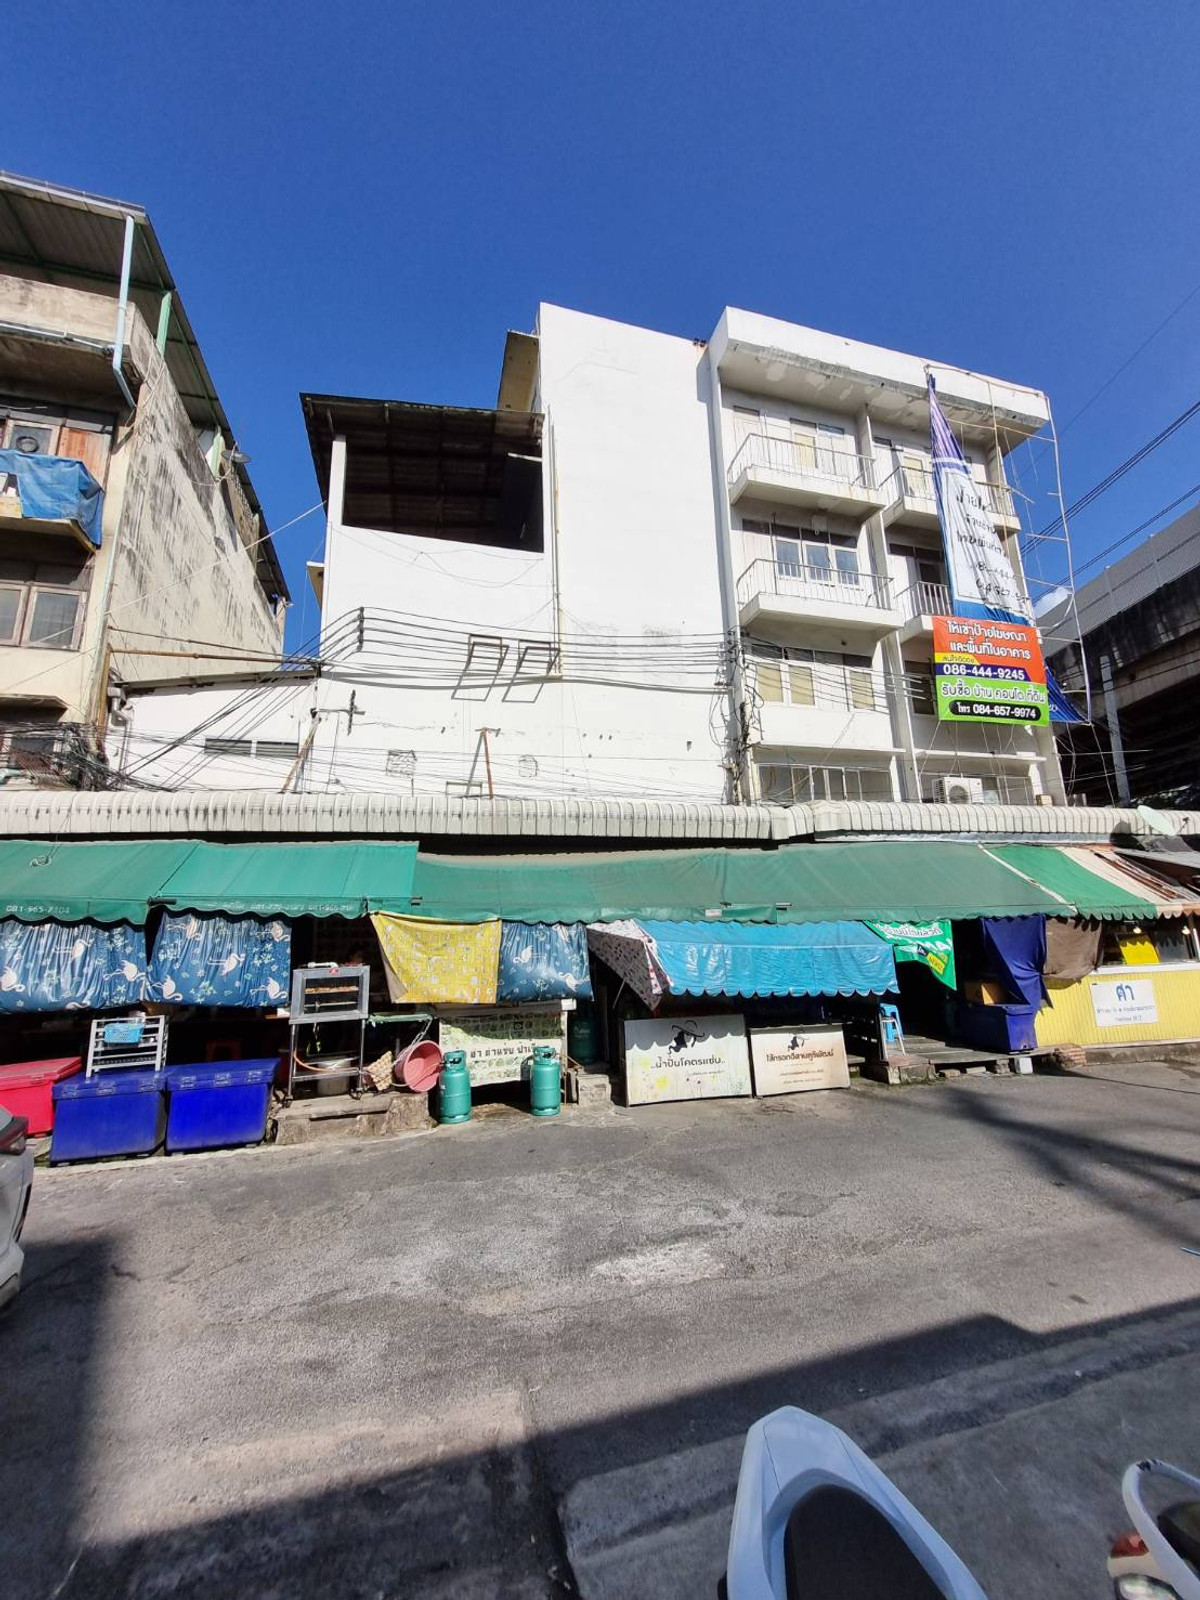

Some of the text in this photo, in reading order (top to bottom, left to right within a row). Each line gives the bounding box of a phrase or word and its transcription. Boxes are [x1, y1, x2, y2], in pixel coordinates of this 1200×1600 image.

[943, 664, 1025, 680] 086-444-9245
[942, 678, 1046, 702] รับซื้อ บ้าน คอนโด ที่ดิน
[956, 702, 971, 713] โทร
[972, 703, 1037, 718] 084-657-9974
